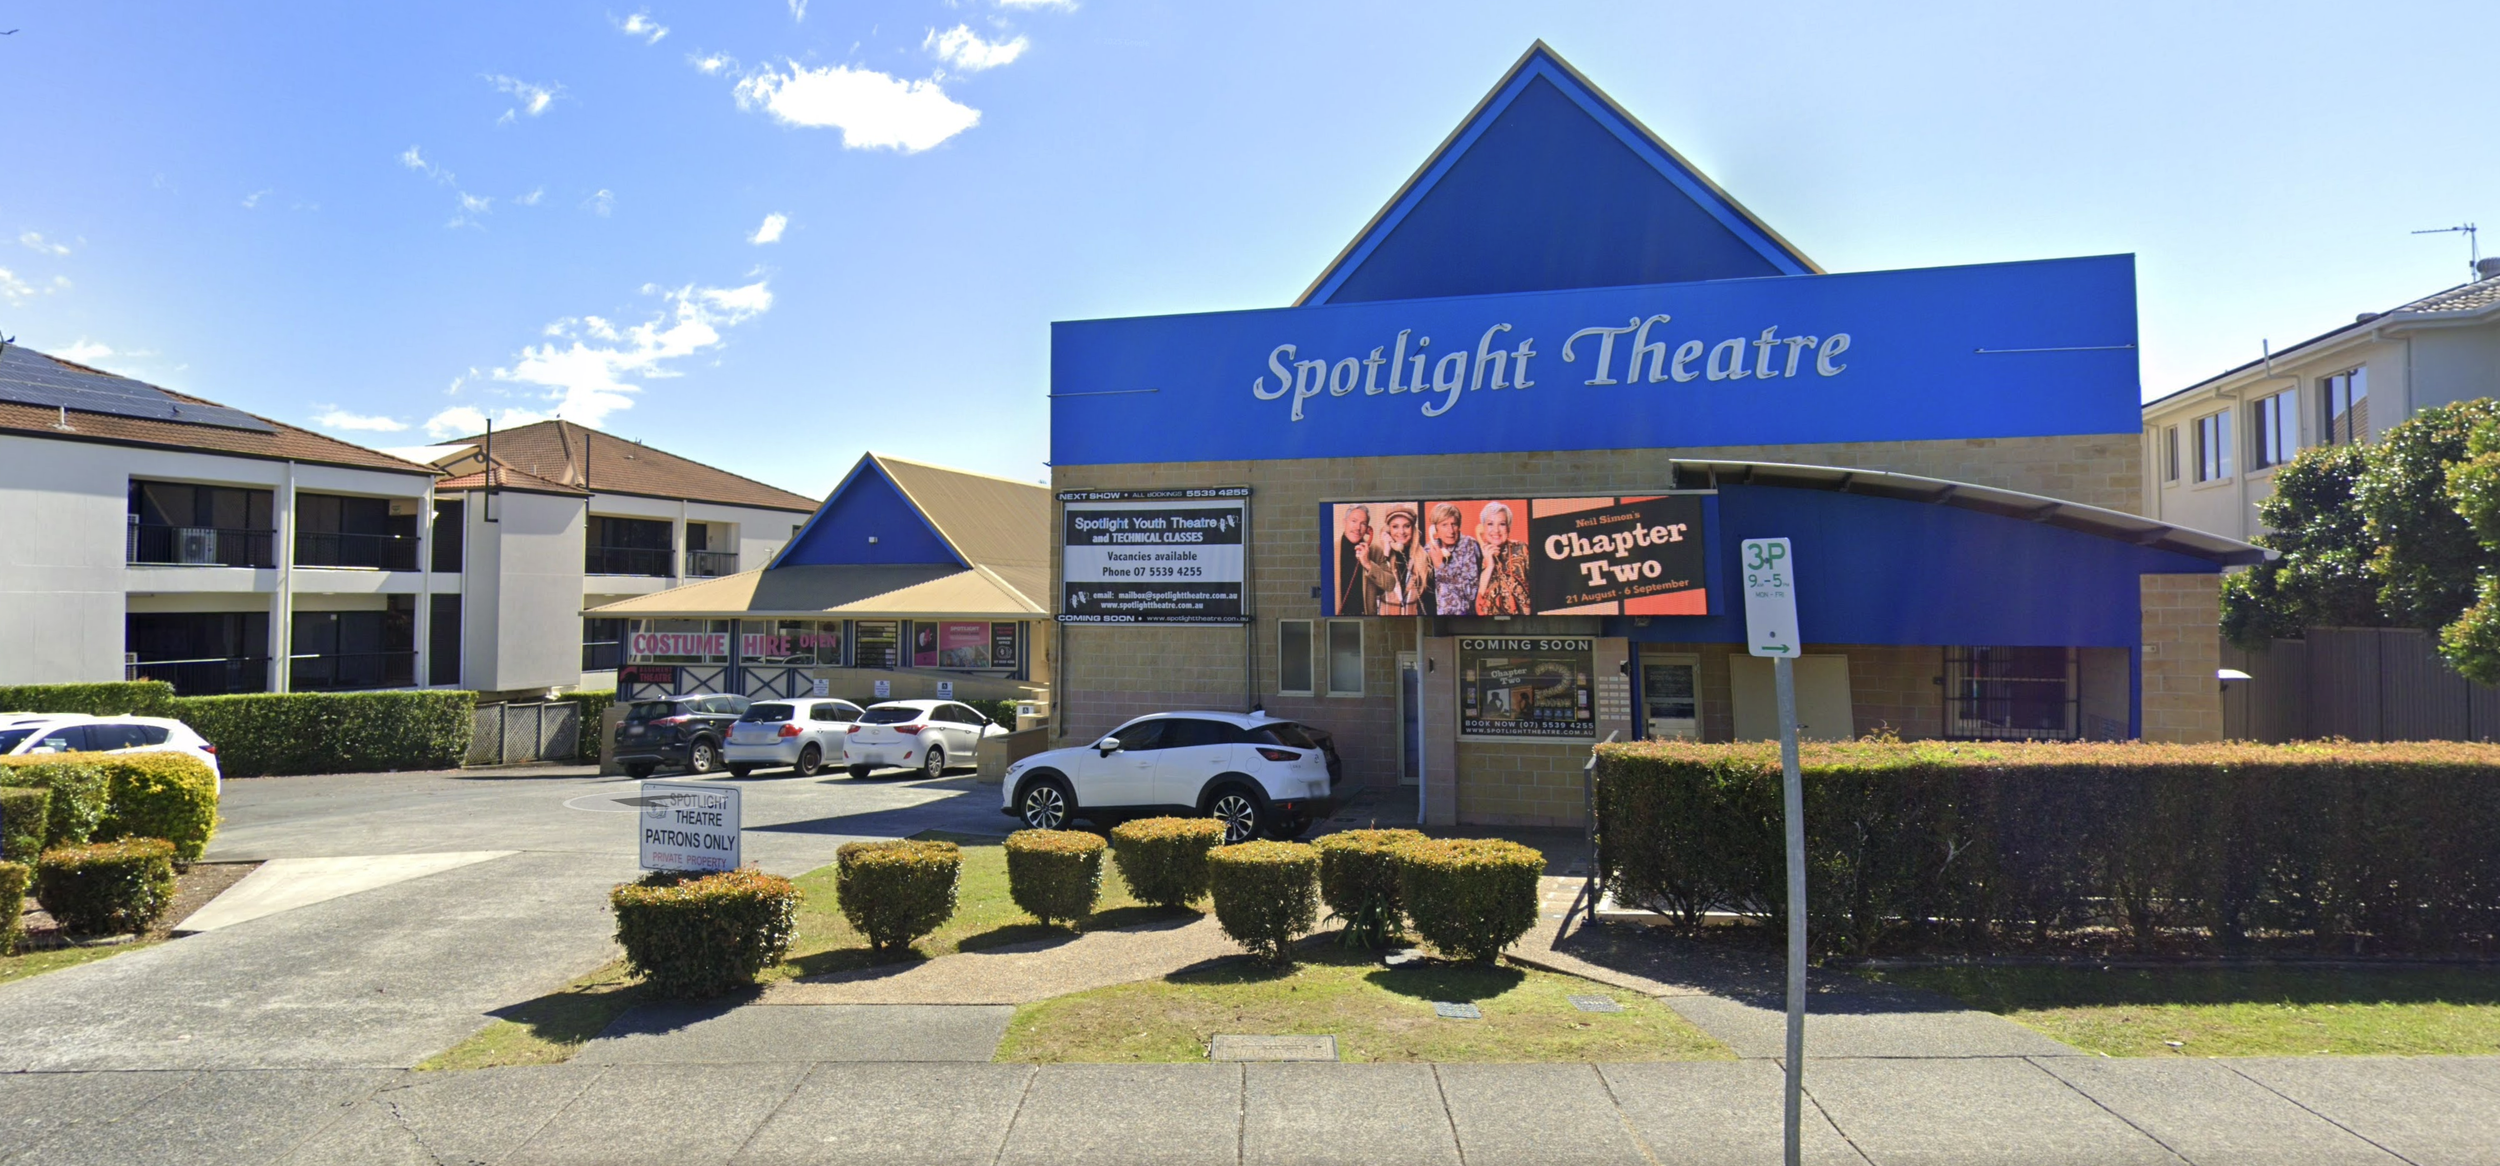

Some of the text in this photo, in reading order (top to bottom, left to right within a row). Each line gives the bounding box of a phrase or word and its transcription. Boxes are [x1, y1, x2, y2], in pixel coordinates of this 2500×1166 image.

[1252, 313, 1851, 422] Spotlight Theatre
[1059, 492, 1087, 500] NEXT
[1089, 491, 1121, 499] SHOW
[1218, 488, 1249, 496] 4255
[1075, 517, 1217, 532] Spotlight Youth Theatre
[1575, 510, 1641, 528] Neil Simon's
[1092, 532, 1203, 543] and TECHNICAL CLASSES
[1544, 522, 1688, 560] Chapter
[1107, 551, 1198, 561] Vacancies available
[1747, 543, 1786, 570] 3P
[1102, 567, 1203, 577] Phone 07 5539 4255
[1580, 558, 1662, 588] Two
[1092, 591, 1238, 602] email: mailbox@spotlighttheatre.com.au
[1565, 595, 1578, 604] 21
[1581, 589, 1617, 603] August
[1624, 586, 1631, 595] 6
[1632, 579, 1690, 596] September
[1101, 601, 1204, 611] www.spotlighttheatre.com.au
[1058, 614, 1101, 622] COMING
[633, 633, 837, 656] COSTUME HIRE OPEN
[1463, 640, 1589, 651] COMING SOON
[639, 673, 672, 682] THEATRE
[1491, 668, 1527, 678] Chapter
[1500, 677, 1521, 685] Two
[1519, 721, 1539, 729] (07)
[1466, 728, 1594, 736] WWW.SPOTLIGHTTHEATRE.COM.AU
[669, 792, 729, 810] SPOTLIGHT
[675, 809, 723, 827] THEATRE
[645, 828, 736, 852] PATRONS ONLY
[652, 851, 727, 868] PRIVATE PROPERTY
